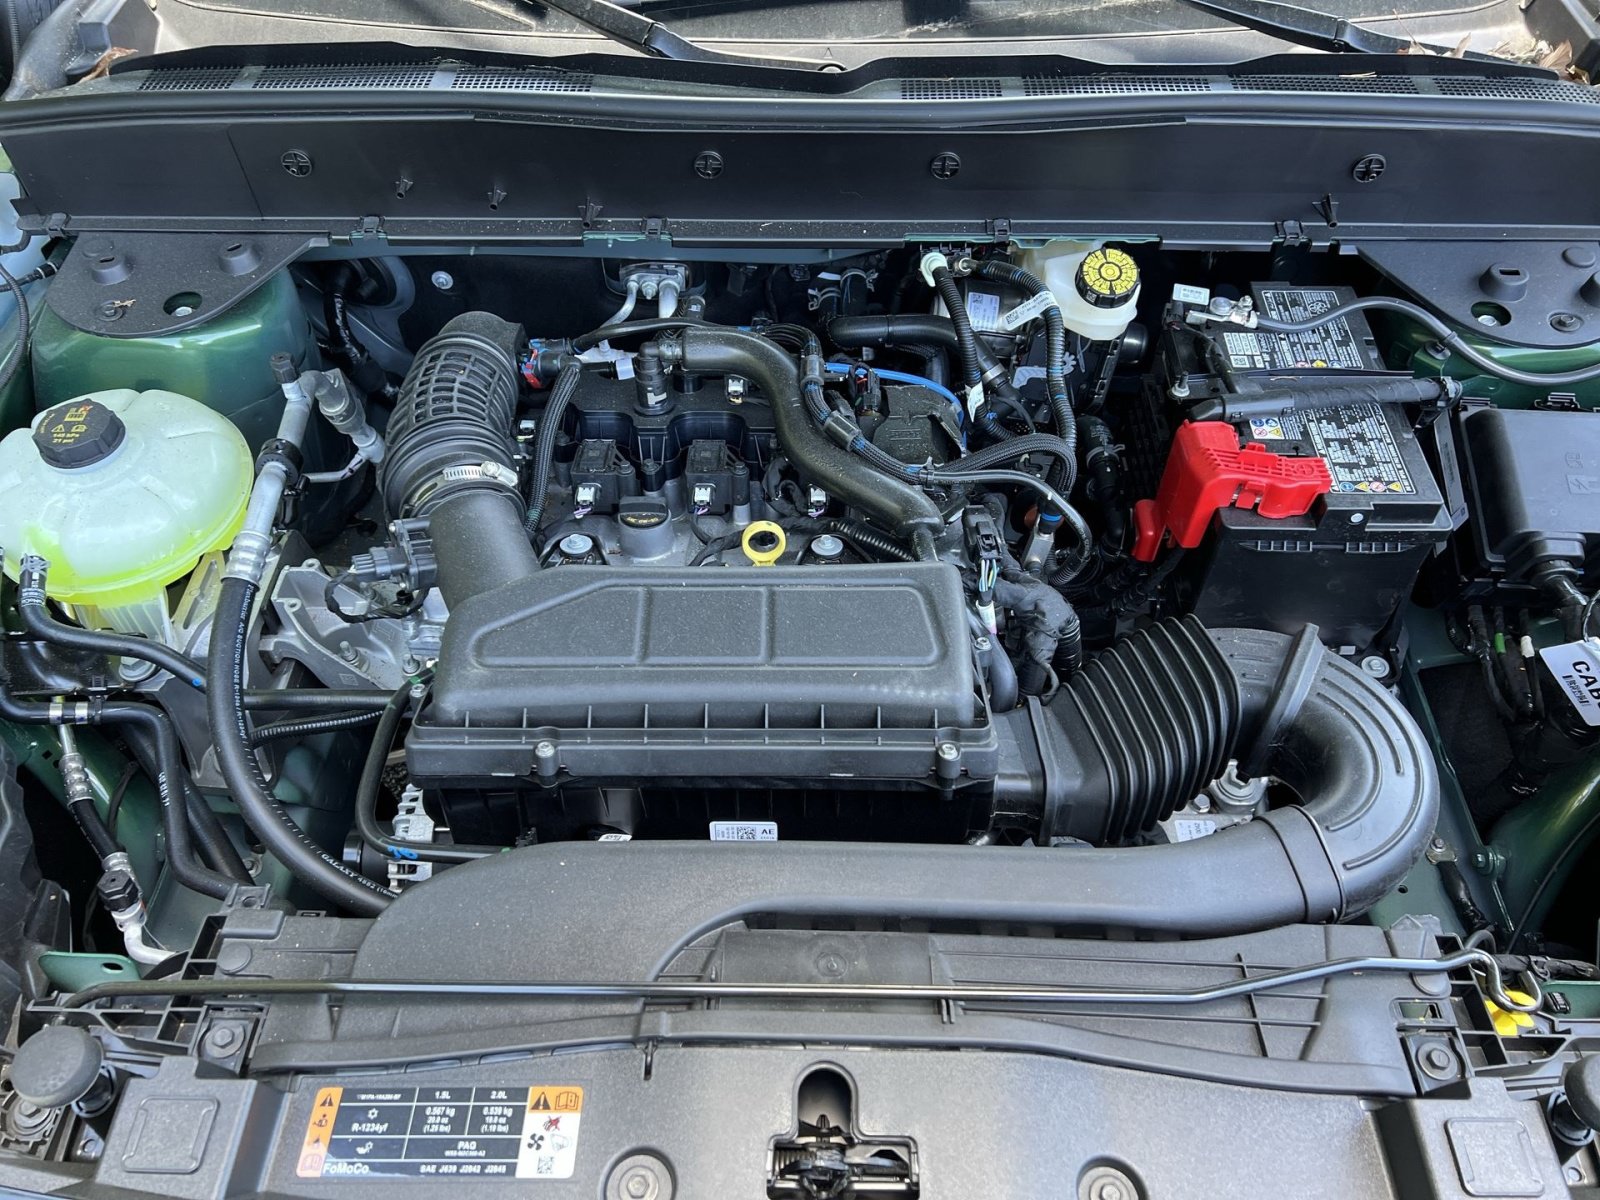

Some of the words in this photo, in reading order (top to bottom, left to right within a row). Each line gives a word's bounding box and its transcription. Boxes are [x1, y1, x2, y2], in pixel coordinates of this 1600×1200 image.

[234, 634, 243, 664] SUCTION
[1572, 660, 1600, 710] CAB
[321, 853, 358, 878] GALAXY
[435, 1090, 451, 1099] 1.5L
[490, 1090, 507, 1099] 2.0L
[445, 1107, 456, 1117] kg
[503, 1107, 513, 1117] kg
[351, 1122, 389, 1134] R-1234yf
[322, 1162, 370, 1175] FoMoCo
[419, 1164, 437, 1174] SAE
